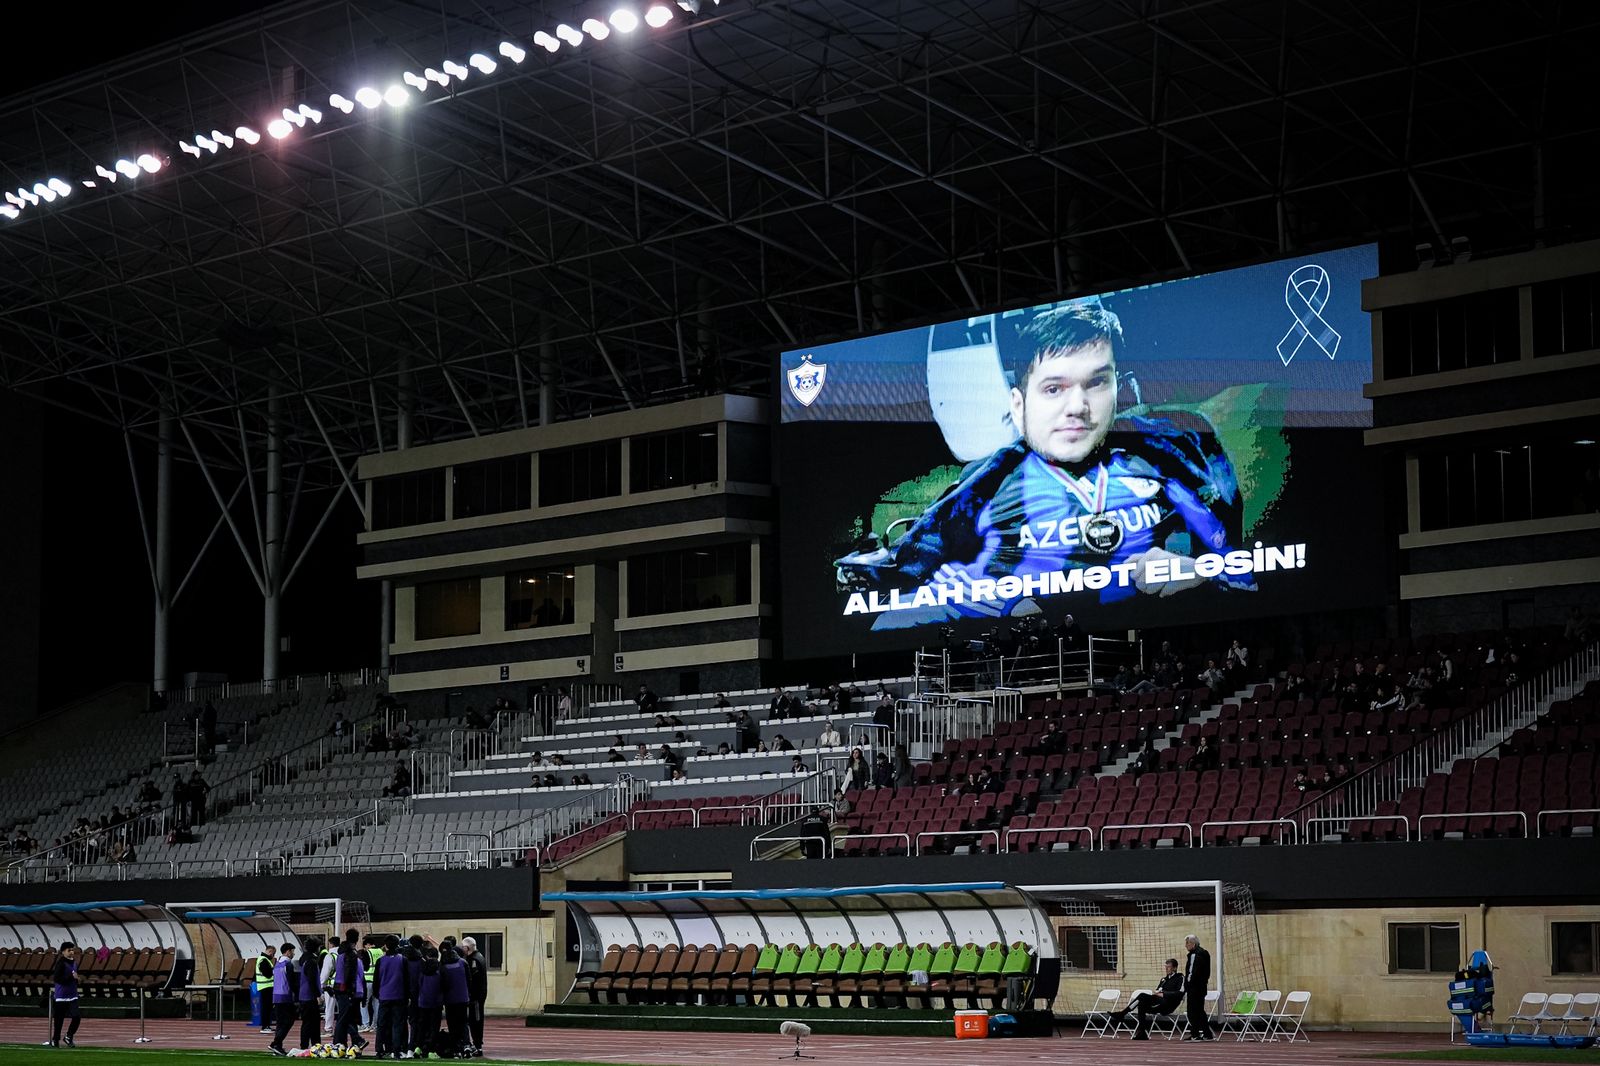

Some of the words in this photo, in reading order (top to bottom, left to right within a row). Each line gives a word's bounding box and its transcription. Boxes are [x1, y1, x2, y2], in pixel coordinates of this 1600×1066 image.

[843, 582, 964, 615] ALLAH
[971, 562, 1137, 603] RƏHMƏT
[1145, 541, 1306, 584] ELƏSİN!
